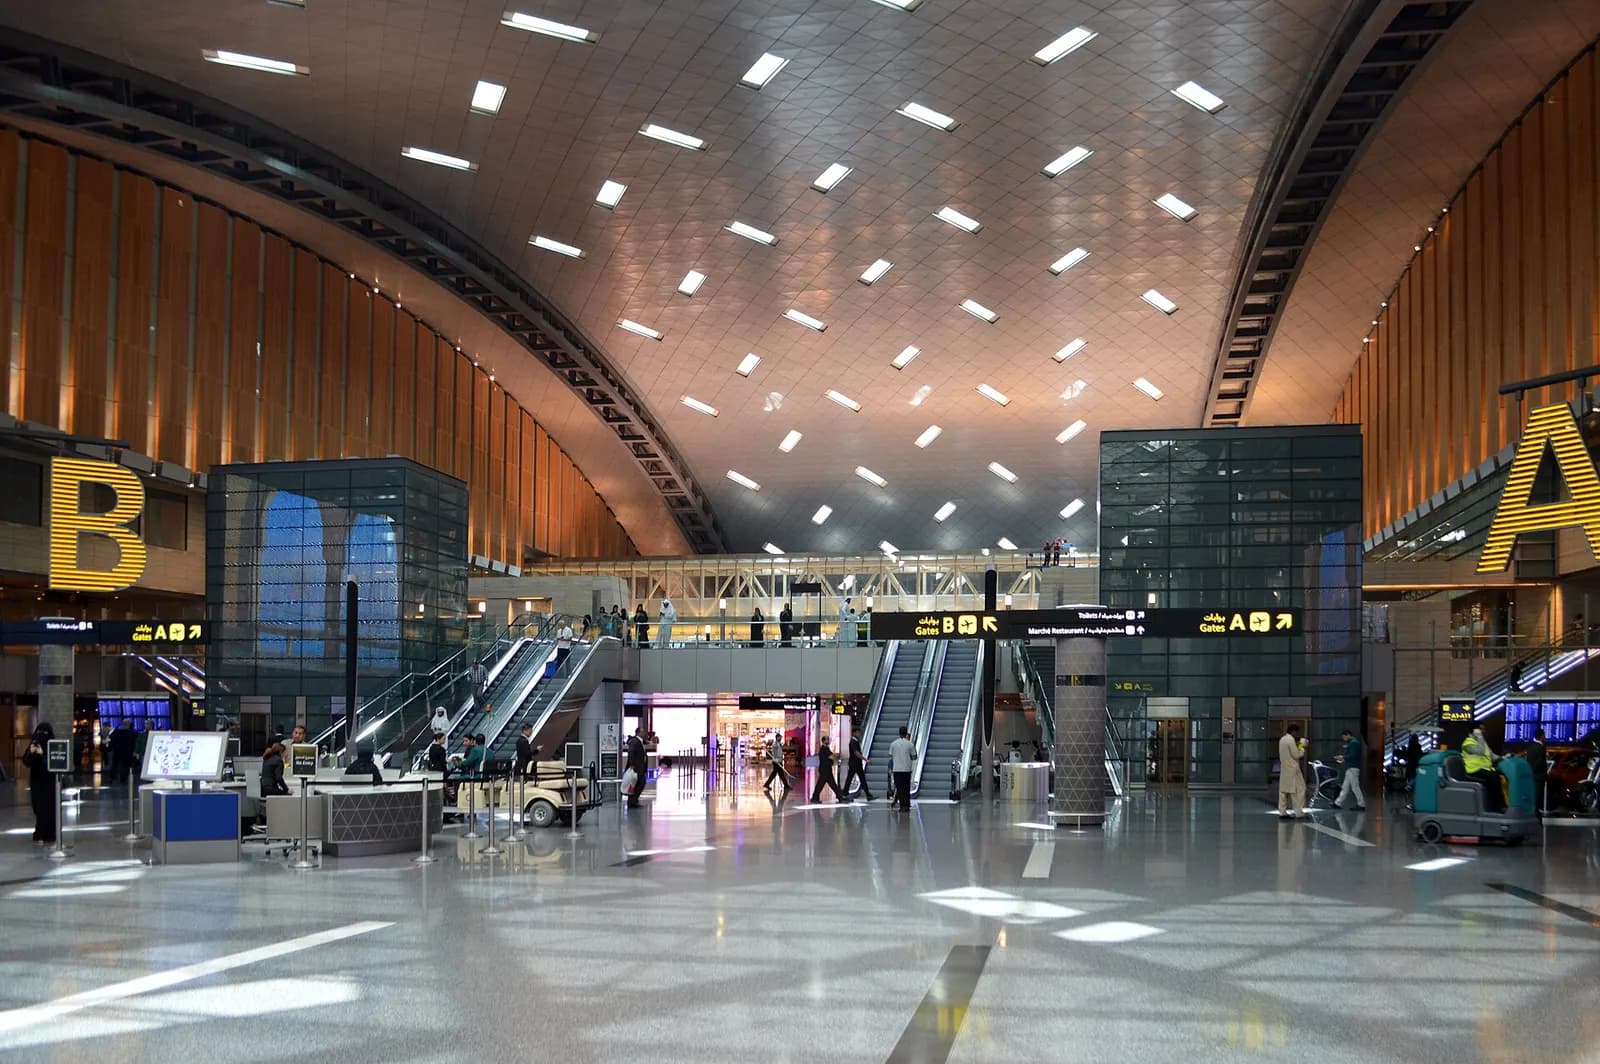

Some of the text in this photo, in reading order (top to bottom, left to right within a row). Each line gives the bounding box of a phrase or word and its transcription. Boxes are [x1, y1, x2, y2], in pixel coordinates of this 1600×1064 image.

[1475, 402, 1600, 575] A
[49, 457, 147, 592] B
[942, 616, 955, 634] B
[1200, 623, 1226, 632] Gates
[1229, 614, 1246, 631] A
[132, 632, 152, 641] Gates
[154, 624, 167, 640] A
[915, 627, 939, 636] Gates
[1051, 627, 1084, 635] Restaurant
